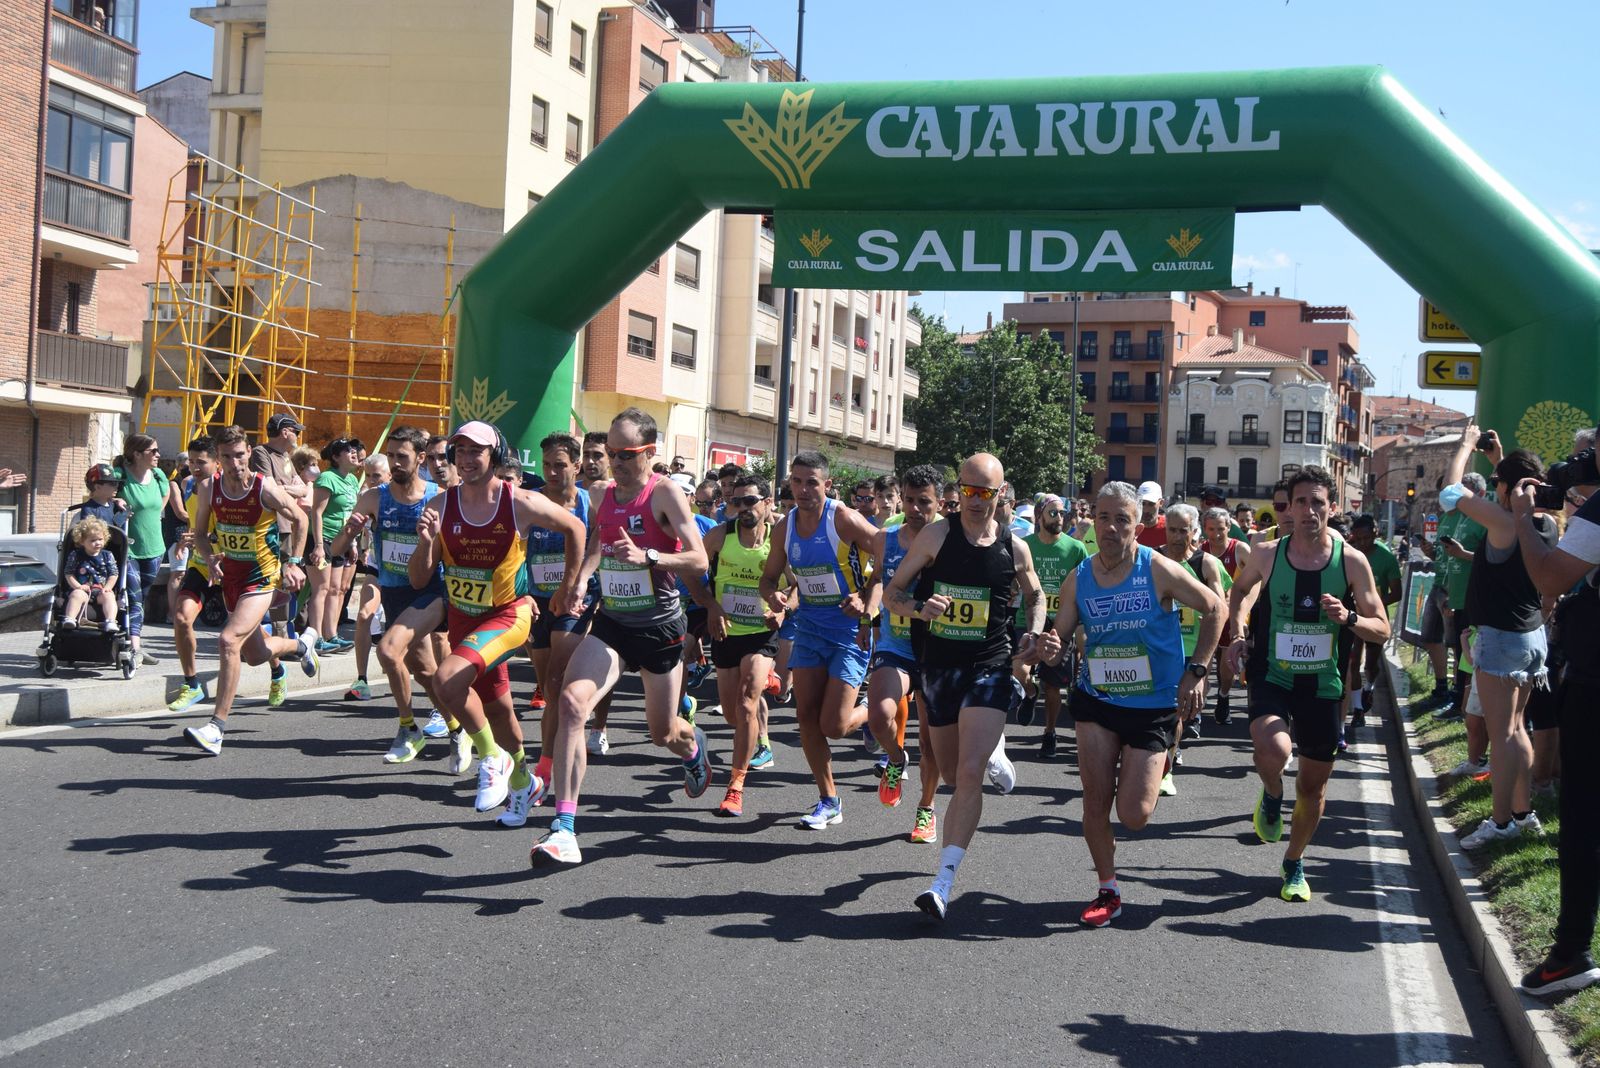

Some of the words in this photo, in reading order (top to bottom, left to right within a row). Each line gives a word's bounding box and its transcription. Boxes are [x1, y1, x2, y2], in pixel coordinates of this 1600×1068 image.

[865, 104, 1028, 162] CAJA
[1033, 96, 1281, 157] RURAL
[855, 229, 1139, 273] SALIDA
[788, 260, 810, 269] CAJA
[810, 260, 843, 270] RURAL
[1152, 262, 1178, 271] CAJA
[1179, 260, 1215, 271] RURAL
[222, 534, 250, 550] 182
[397, 552, 410, 562] NIE
[543, 571, 565, 581] GOME
[1132, 576, 1147, 586] HH
[451, 579, 487, 603] 227
[609, 582, 641, 596] GARGAR
[807, 582, 827, 594] CODE
[949, 586, 983, 595] FUNDACION
[1115, 590, 1150, 601] COMERCIAL
[733, 602, 757, 615] JORGE
[1115, 597, 1151, 614] ULSA
[943, 601, 974, 624] 49
[944, 628, 960, 636] CAJA
[961, 629, 984, 637] RURAL
[1090, 618, 1147, 634] ATLETISMO
[1291, 642, 1317, 658] PEÓN
[1104, 669, 1137, 683] MANSO
[1127, 684, 1150, 692] RURAL
